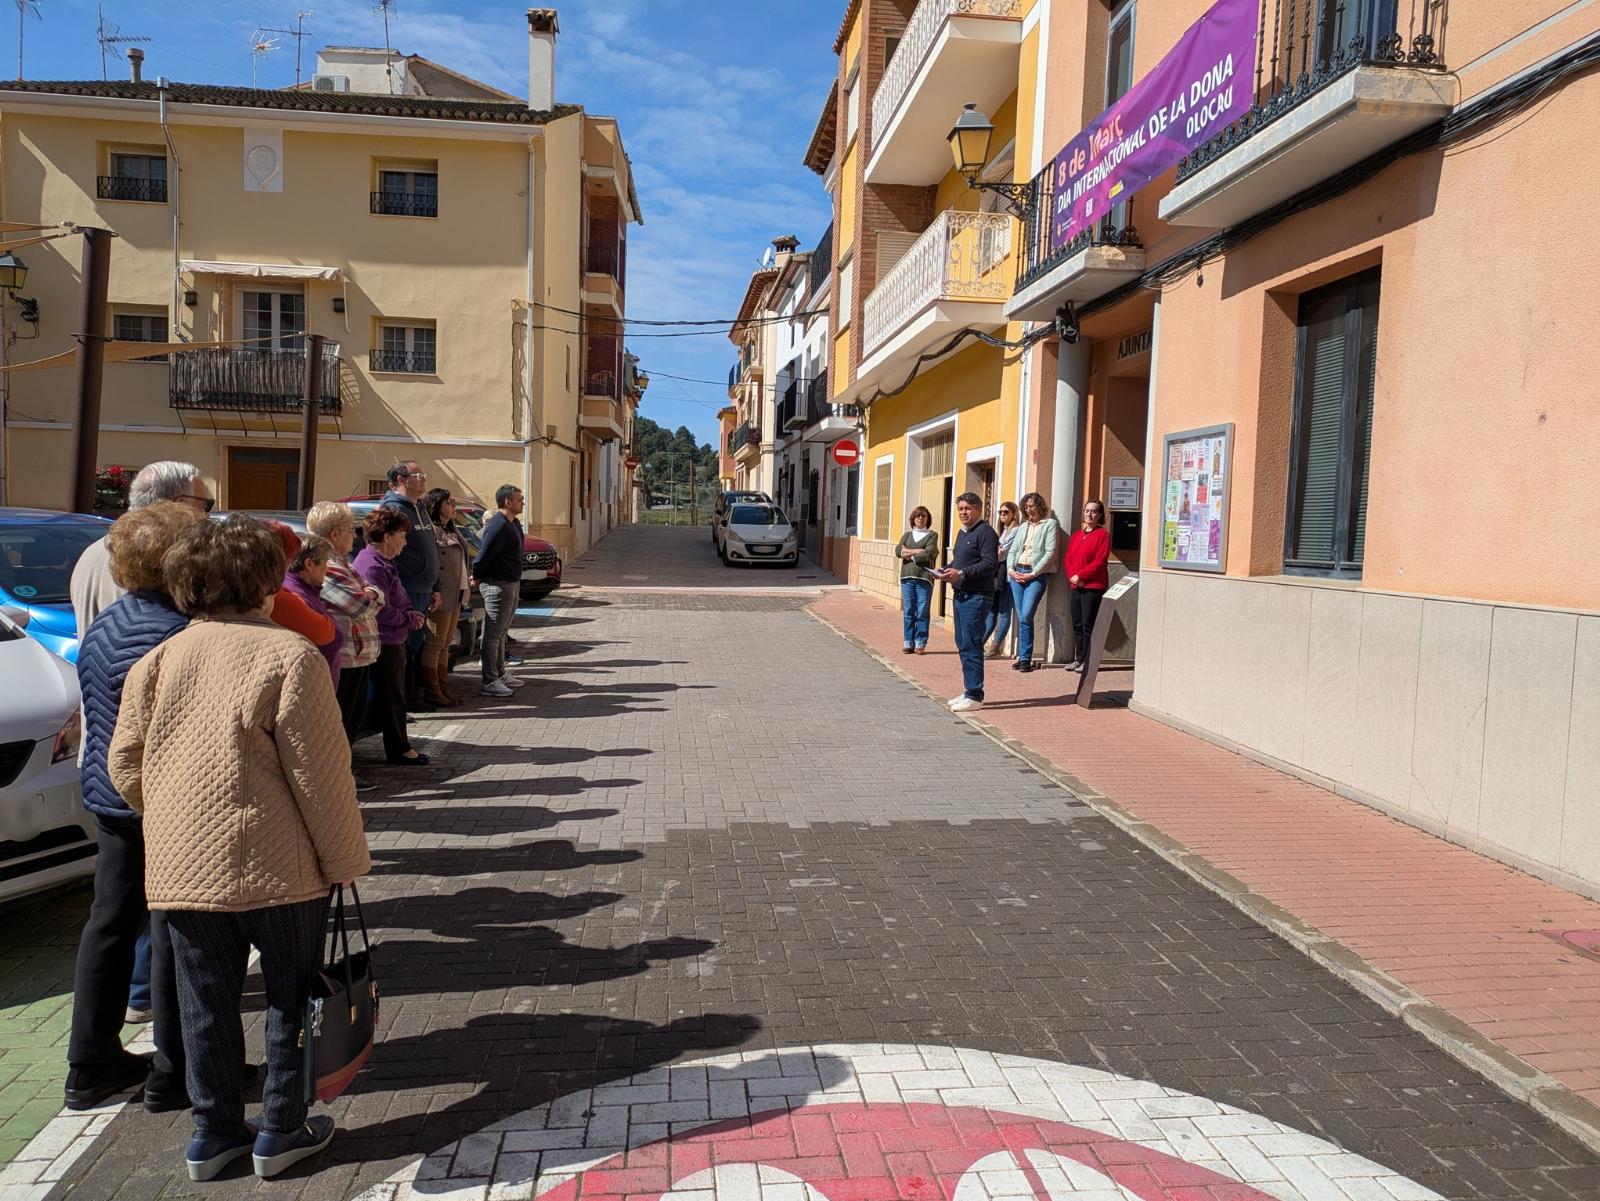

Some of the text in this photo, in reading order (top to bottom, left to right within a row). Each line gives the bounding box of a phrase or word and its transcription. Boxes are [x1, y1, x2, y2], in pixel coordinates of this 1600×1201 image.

[1057, 188, 1071, 214] DIA
[1073, 125, 1147, 201] INTERNACIONAL
[1149, 106, 1167, 140] DE
[1170, 92, 1187, 124] LA
[1190, 53, 1233, 108] DONA
[1186, 84, 1233, 139] OLOCAU
[1058, 114, 1124, 187] 8 de Març
